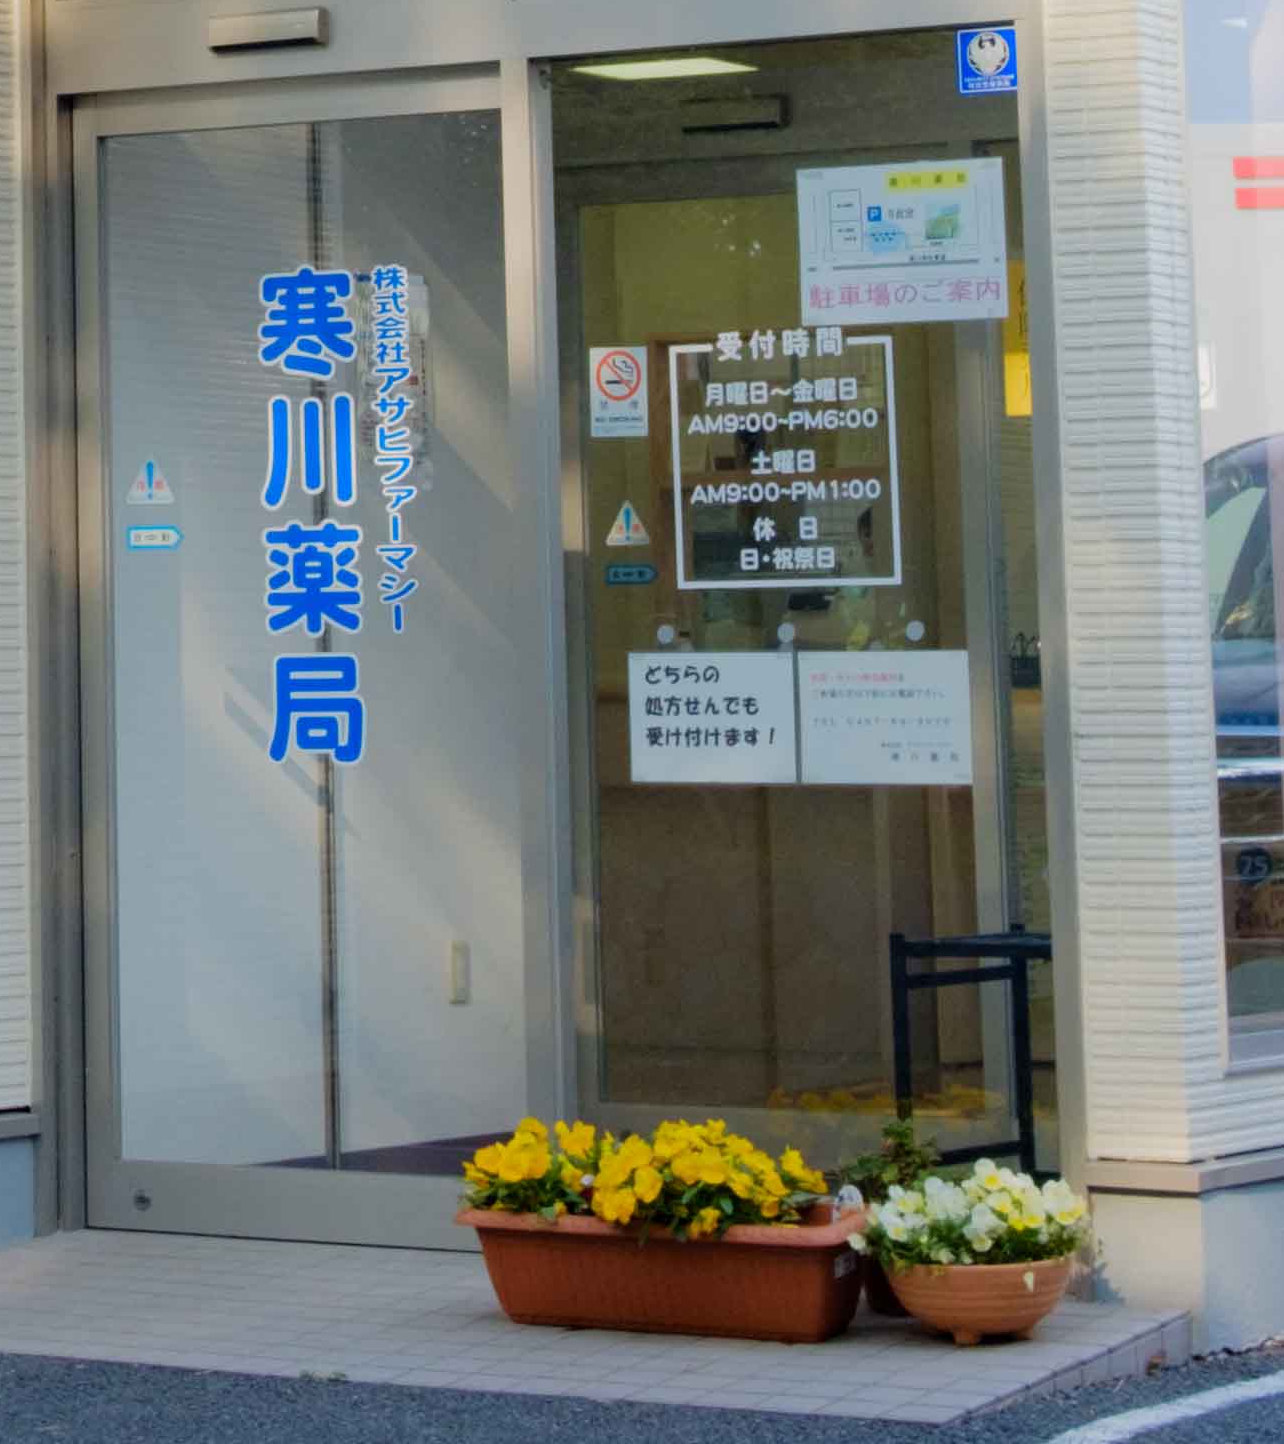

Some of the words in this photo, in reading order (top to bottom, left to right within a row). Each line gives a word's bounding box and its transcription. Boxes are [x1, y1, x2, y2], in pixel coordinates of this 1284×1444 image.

[809, 278, 1001, 309] 駐車場のご案内
[716, 327, 842, 361] 受付時間
[374, 267, 415, 631] 株式会社アサヒファーマシー
[751, 450, 815, 475] 土曜日
[261, 268, 363, 763] 寒川薬局
[645, 665, 720, 684] どちらの
[645, 696, 759, 716] 処方せんでも
